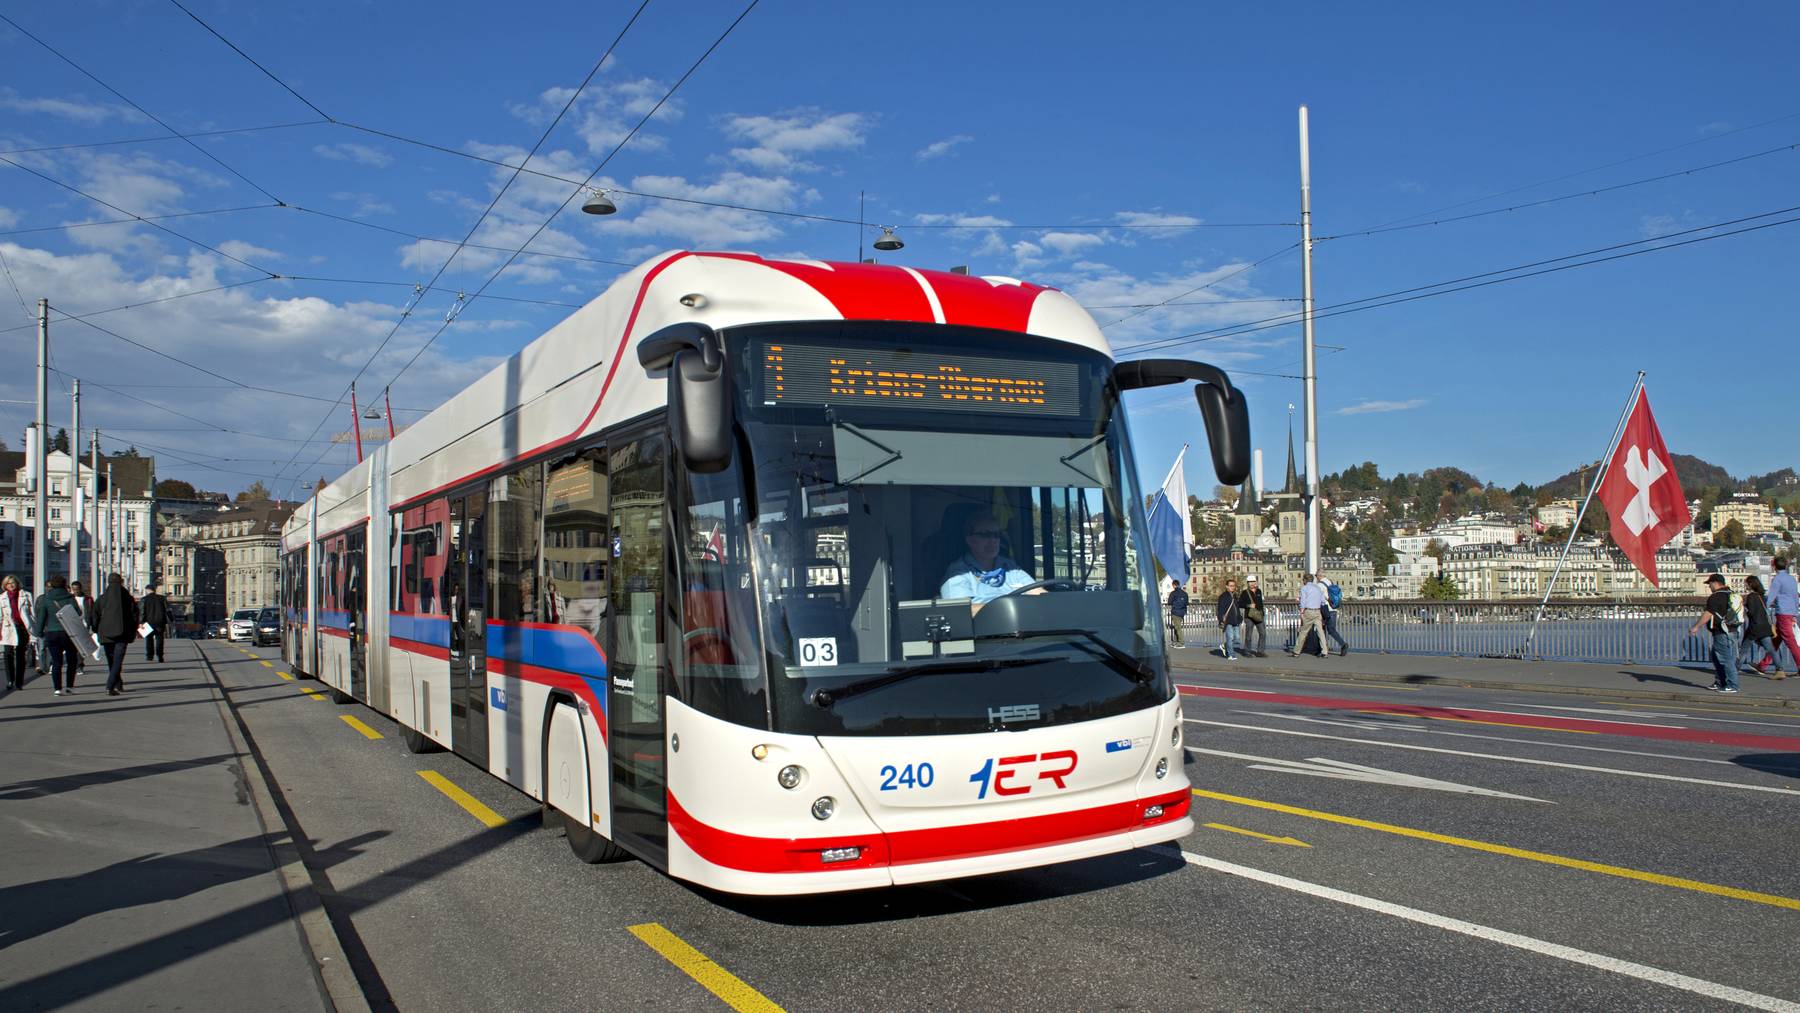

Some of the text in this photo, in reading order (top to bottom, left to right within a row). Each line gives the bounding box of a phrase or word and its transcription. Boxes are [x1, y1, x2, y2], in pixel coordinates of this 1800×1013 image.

[765, 346, 784, 399] 1
[1448, 544, 1483, 552] NATIONAL
[802, 642, 835, 662] 03
[987, 703, 1041, 724] HESS
[879, 762, 935, 791] 240
